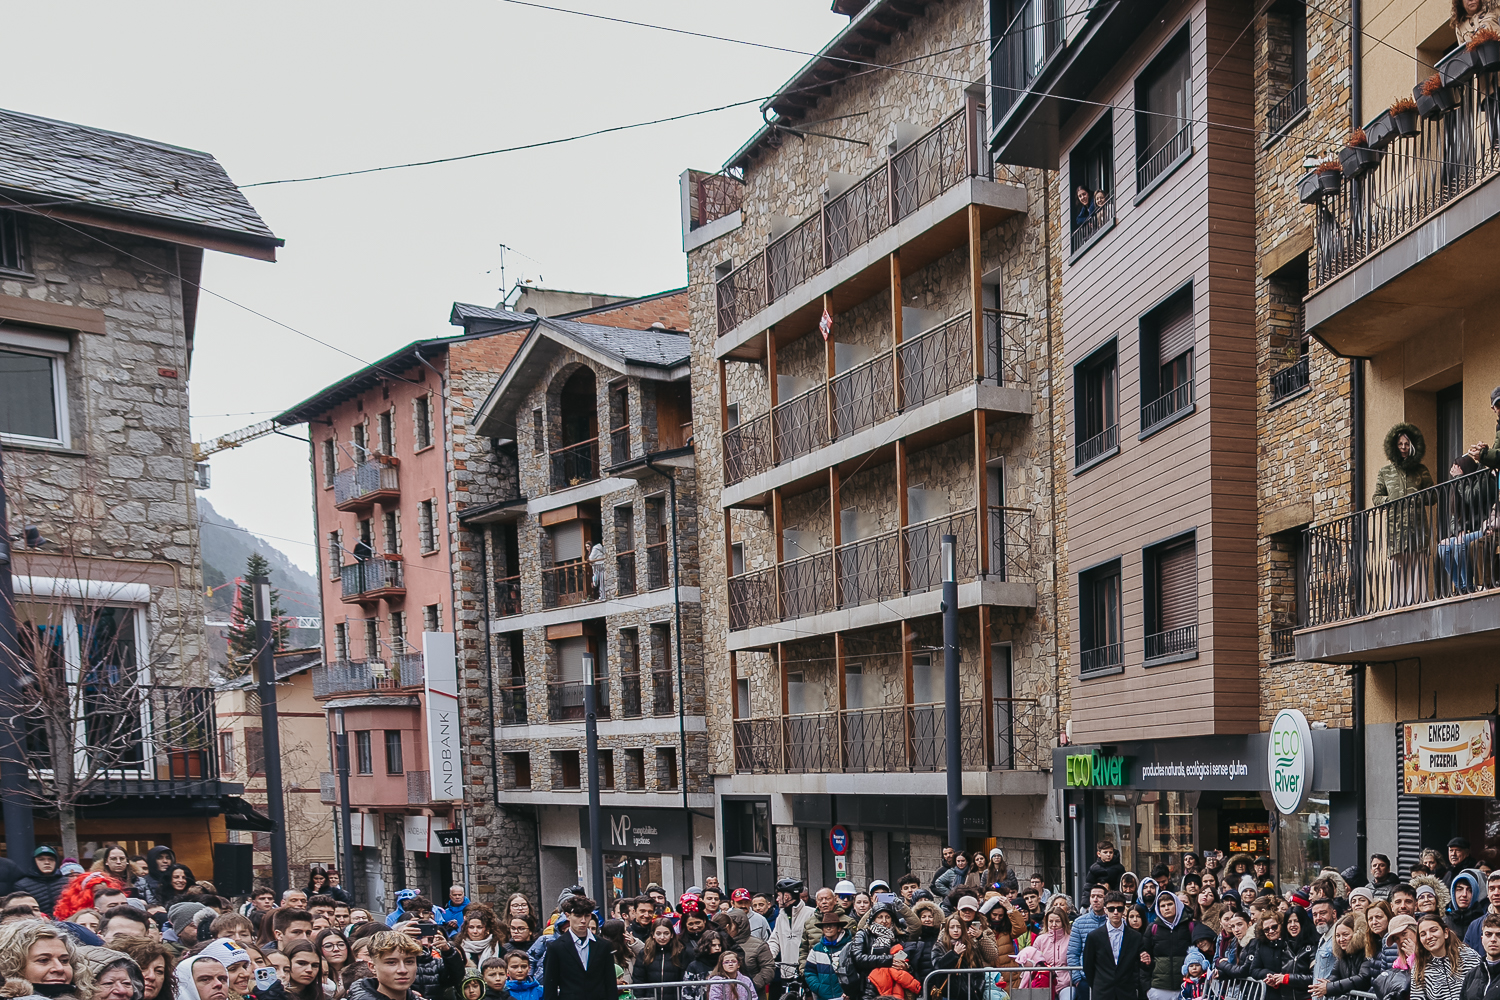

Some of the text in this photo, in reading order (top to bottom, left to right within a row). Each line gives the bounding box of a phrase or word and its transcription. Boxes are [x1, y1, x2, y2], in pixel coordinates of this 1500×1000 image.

[1273, 730, 1299, 756] ECO
[1428, 724, 1460, 743] ENKEBAB
[439, 712, 454, 797] ANDBANK
[1429, 753, 1458, 768] PIZZERIA
[1142, 761, 1164, 781] productes
[1212, 765, 1228, 776] sense
[1229, 760, 1248, 780] gluten
[1274, 768, 1300, 793] River
